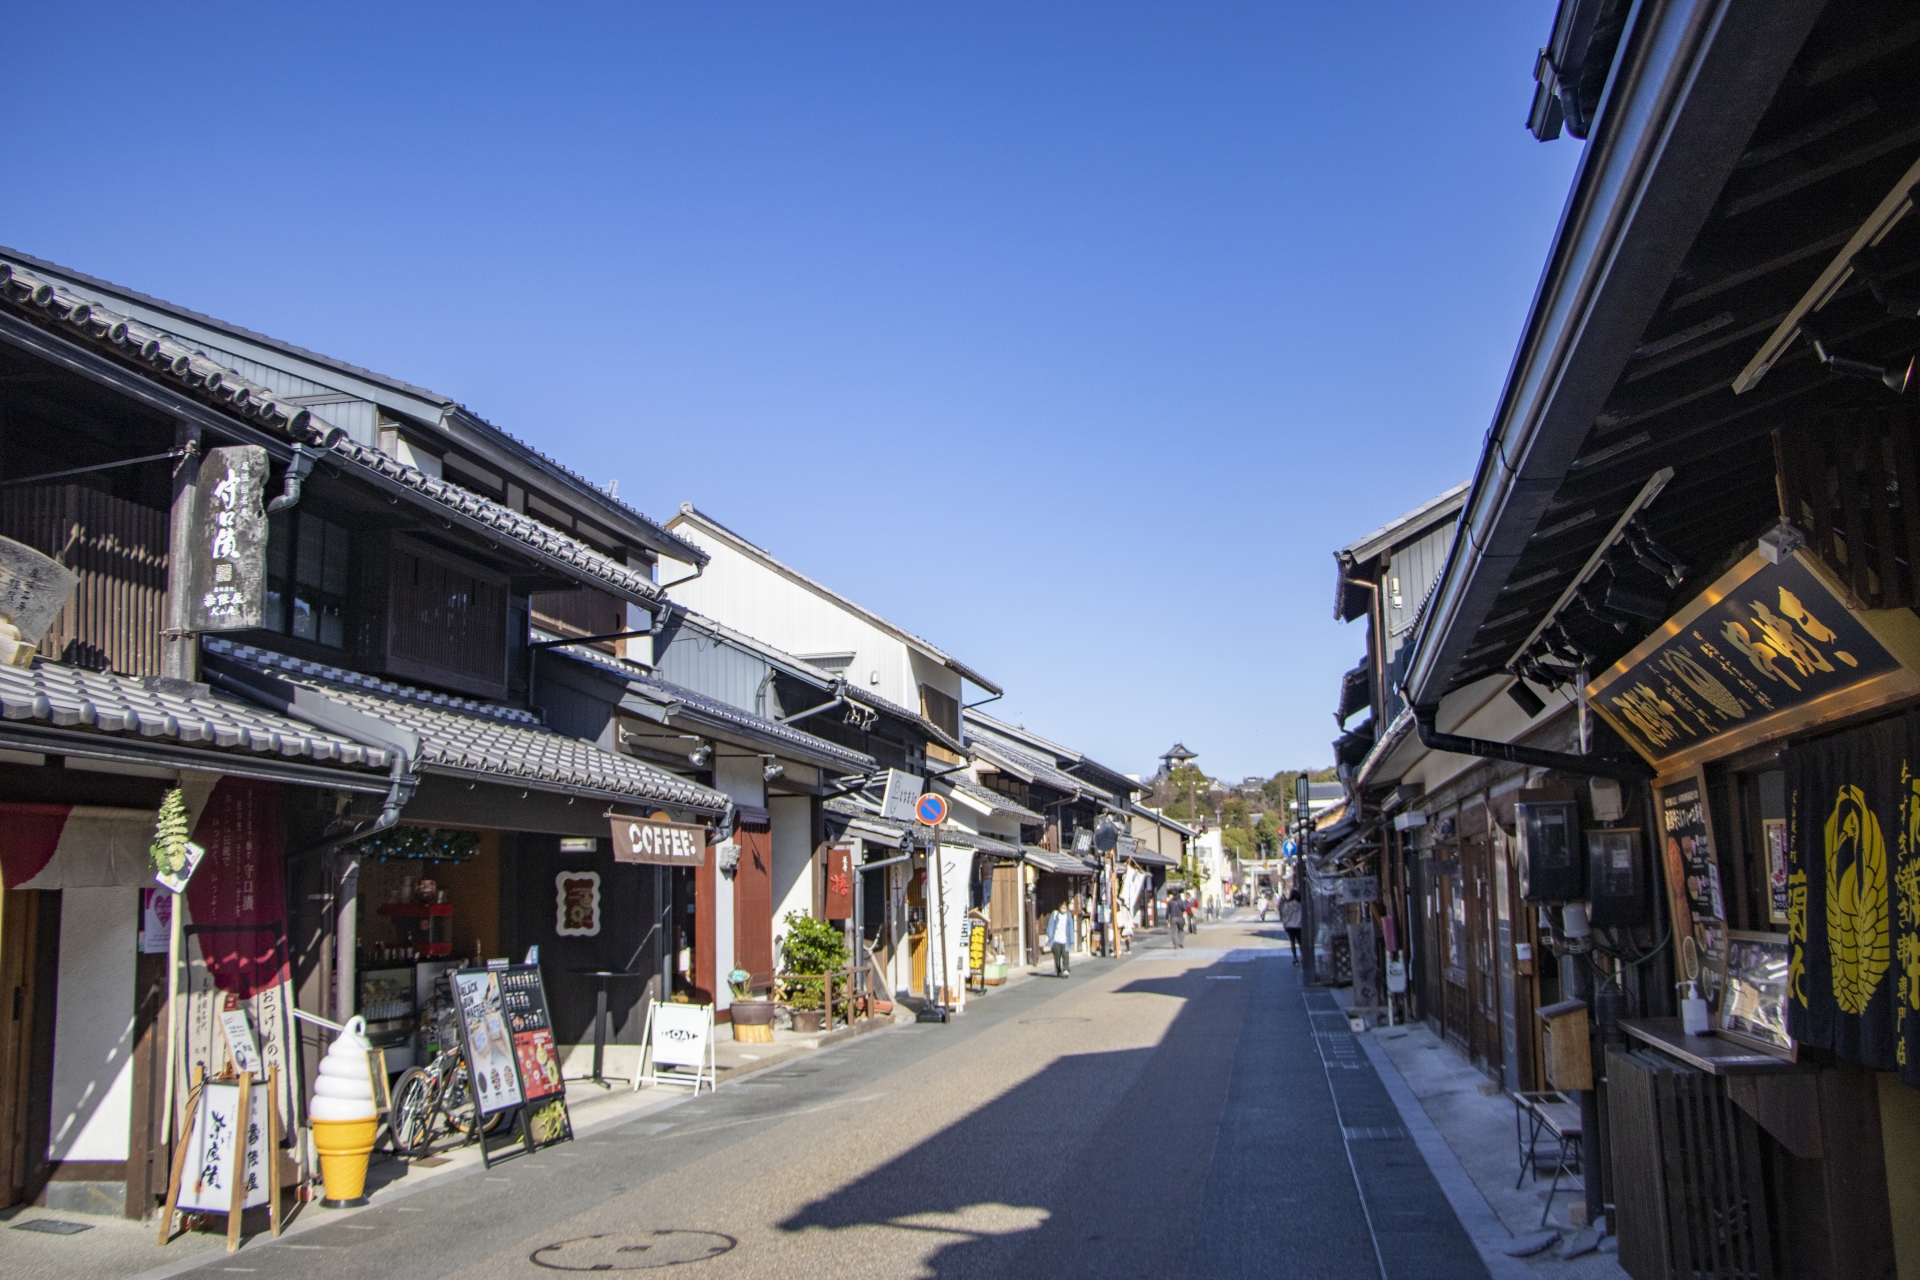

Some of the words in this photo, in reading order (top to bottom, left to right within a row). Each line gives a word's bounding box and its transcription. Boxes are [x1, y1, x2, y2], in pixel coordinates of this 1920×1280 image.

[212, 469, 241, 559] 守口漬
[1720, 586, 1859, 692] 串焼き
[1611, 682, 1698, 748] 飛騨牛
[242, 863, 255, 911] 守口漬
[460, 981, 479, 997] BLACK
[199, 1110, 227, 1190] 奈良漬
